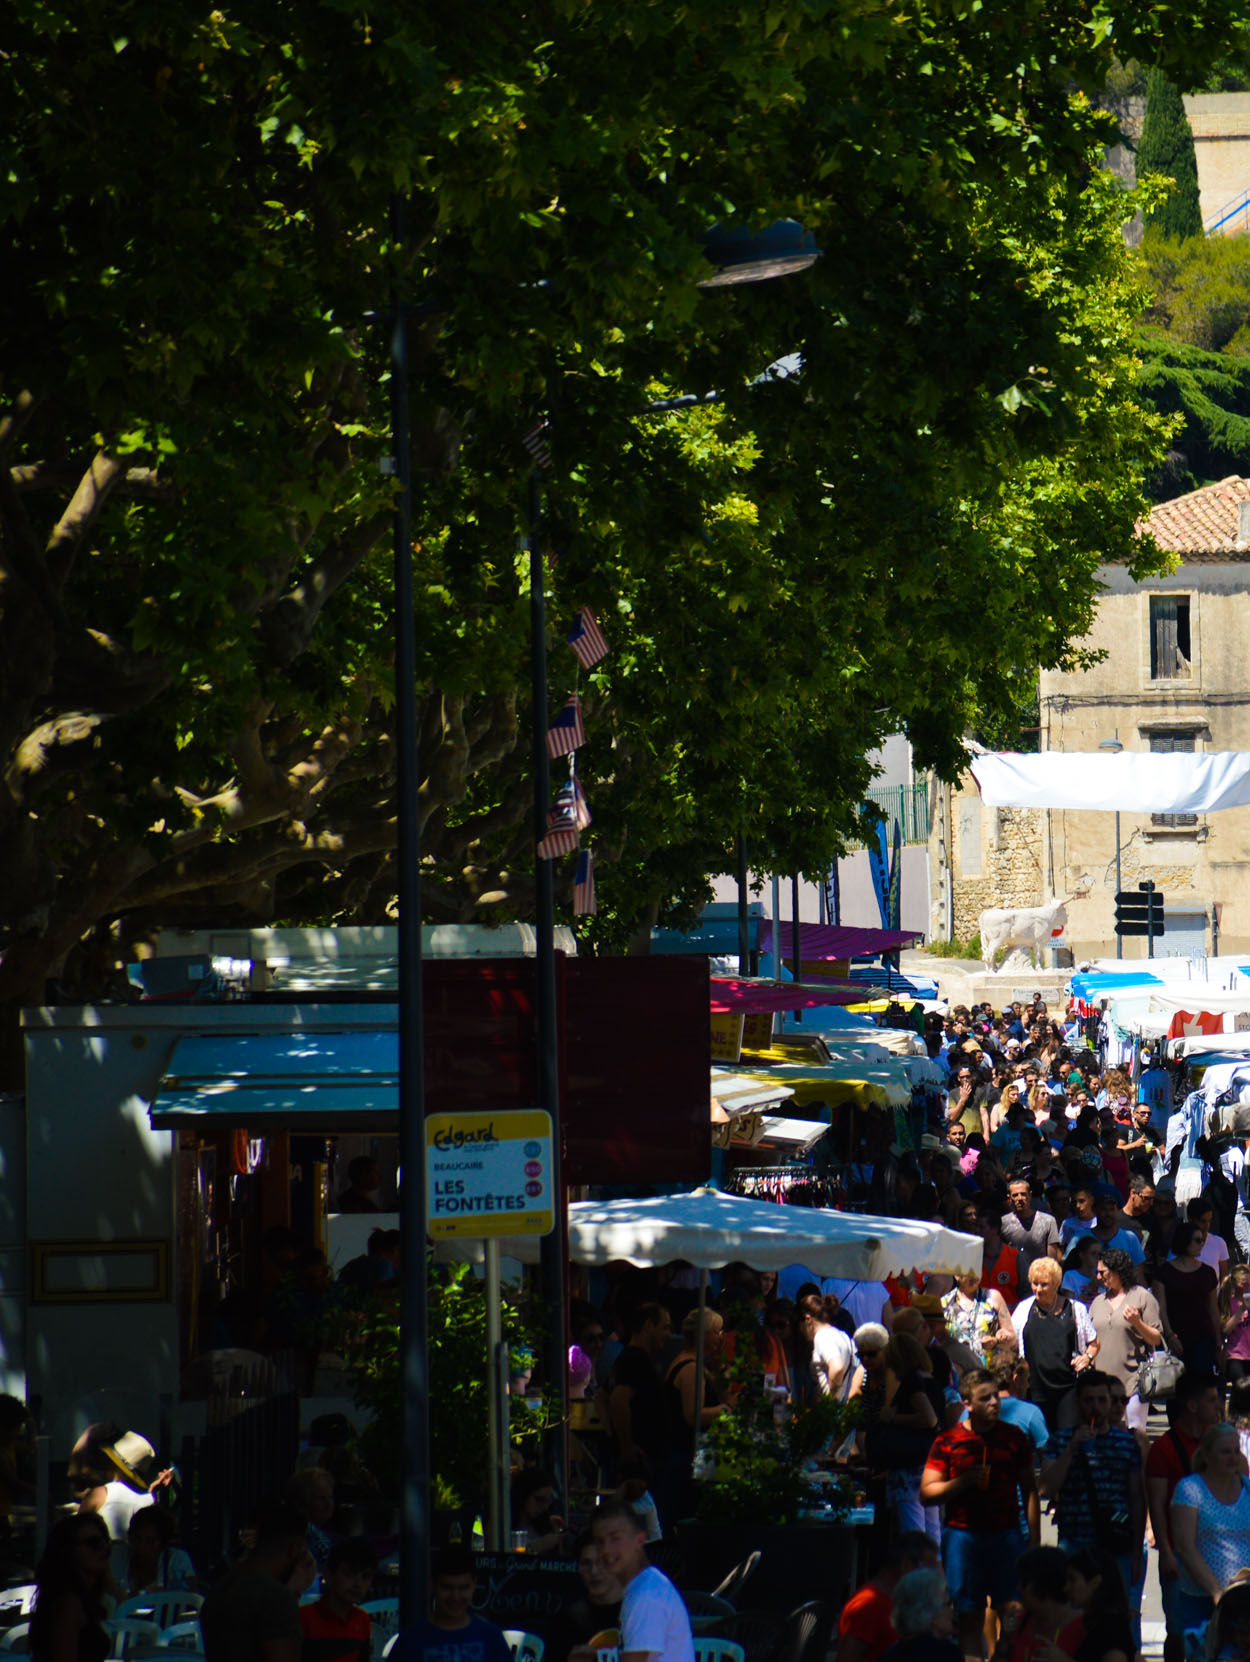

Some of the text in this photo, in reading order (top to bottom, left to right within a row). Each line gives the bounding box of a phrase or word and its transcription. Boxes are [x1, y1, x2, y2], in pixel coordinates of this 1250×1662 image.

[434, 1122, 499, 1151] Edgard
[434, 1161, 484, 1172] BEAUCAIRE
[435, 1180, 465, 1195] LES
[435, 1192, 526, 1213] FONTÊTES
